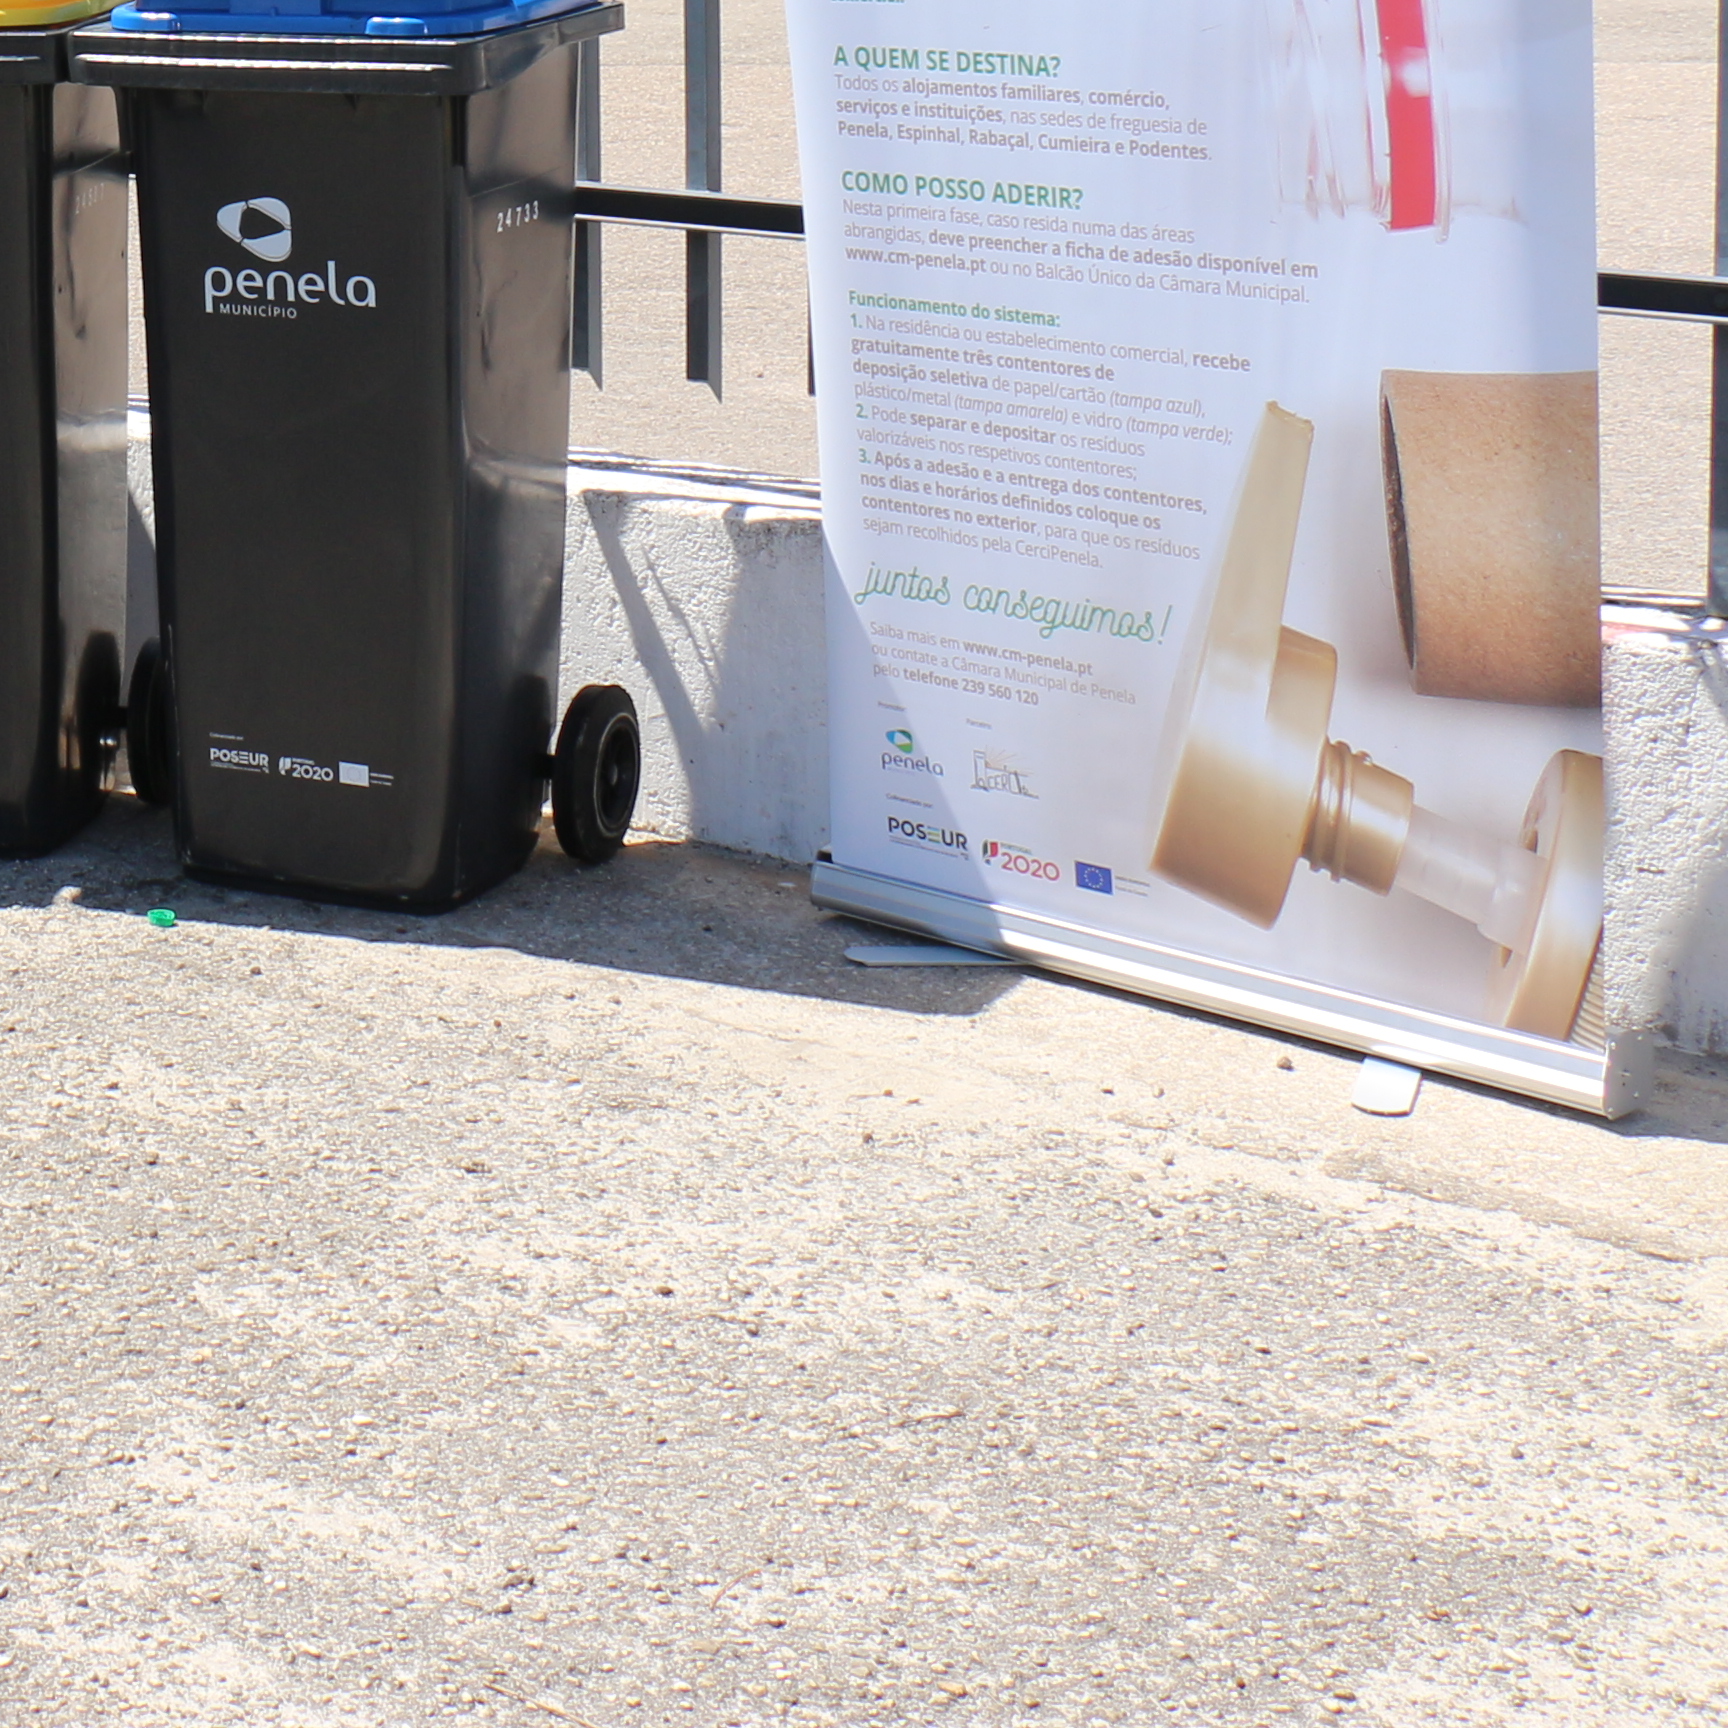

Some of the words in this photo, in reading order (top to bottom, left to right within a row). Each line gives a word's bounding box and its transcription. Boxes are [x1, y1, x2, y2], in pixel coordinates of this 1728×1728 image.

[834, 46, 848, 66] A
[855, 46, 919, 72] QUEM
[926, 50, 949, 72] SE
[956, 51, 1061, 78] DESTINA?
[842, 170, 908, 195] COMO
[915, 176, 985, 202] POSSO
[993, 182, 1083, 210] ADERIR?
[497, 200, 538, 233] 24733
[205, 261, 376, 314] penela
[220, 303, 297, 319] MUNICÍPIO
[849, 290, 967, 317] Funcionamento
[970, 302, 990, 320] do
[994, 305, 1060, 328] sistema:
[854, 561, 951, 605] juntos
[963, 584, 1173, 645] conseguimos!
[210, 748, 269, 766] POSEUR
[292, 764, 334, 781] 2020
[881, 752, 944, 776] penela
[887, 816, 968, 851] POSEUR
[1001, 852, 1060, 881] 2020
